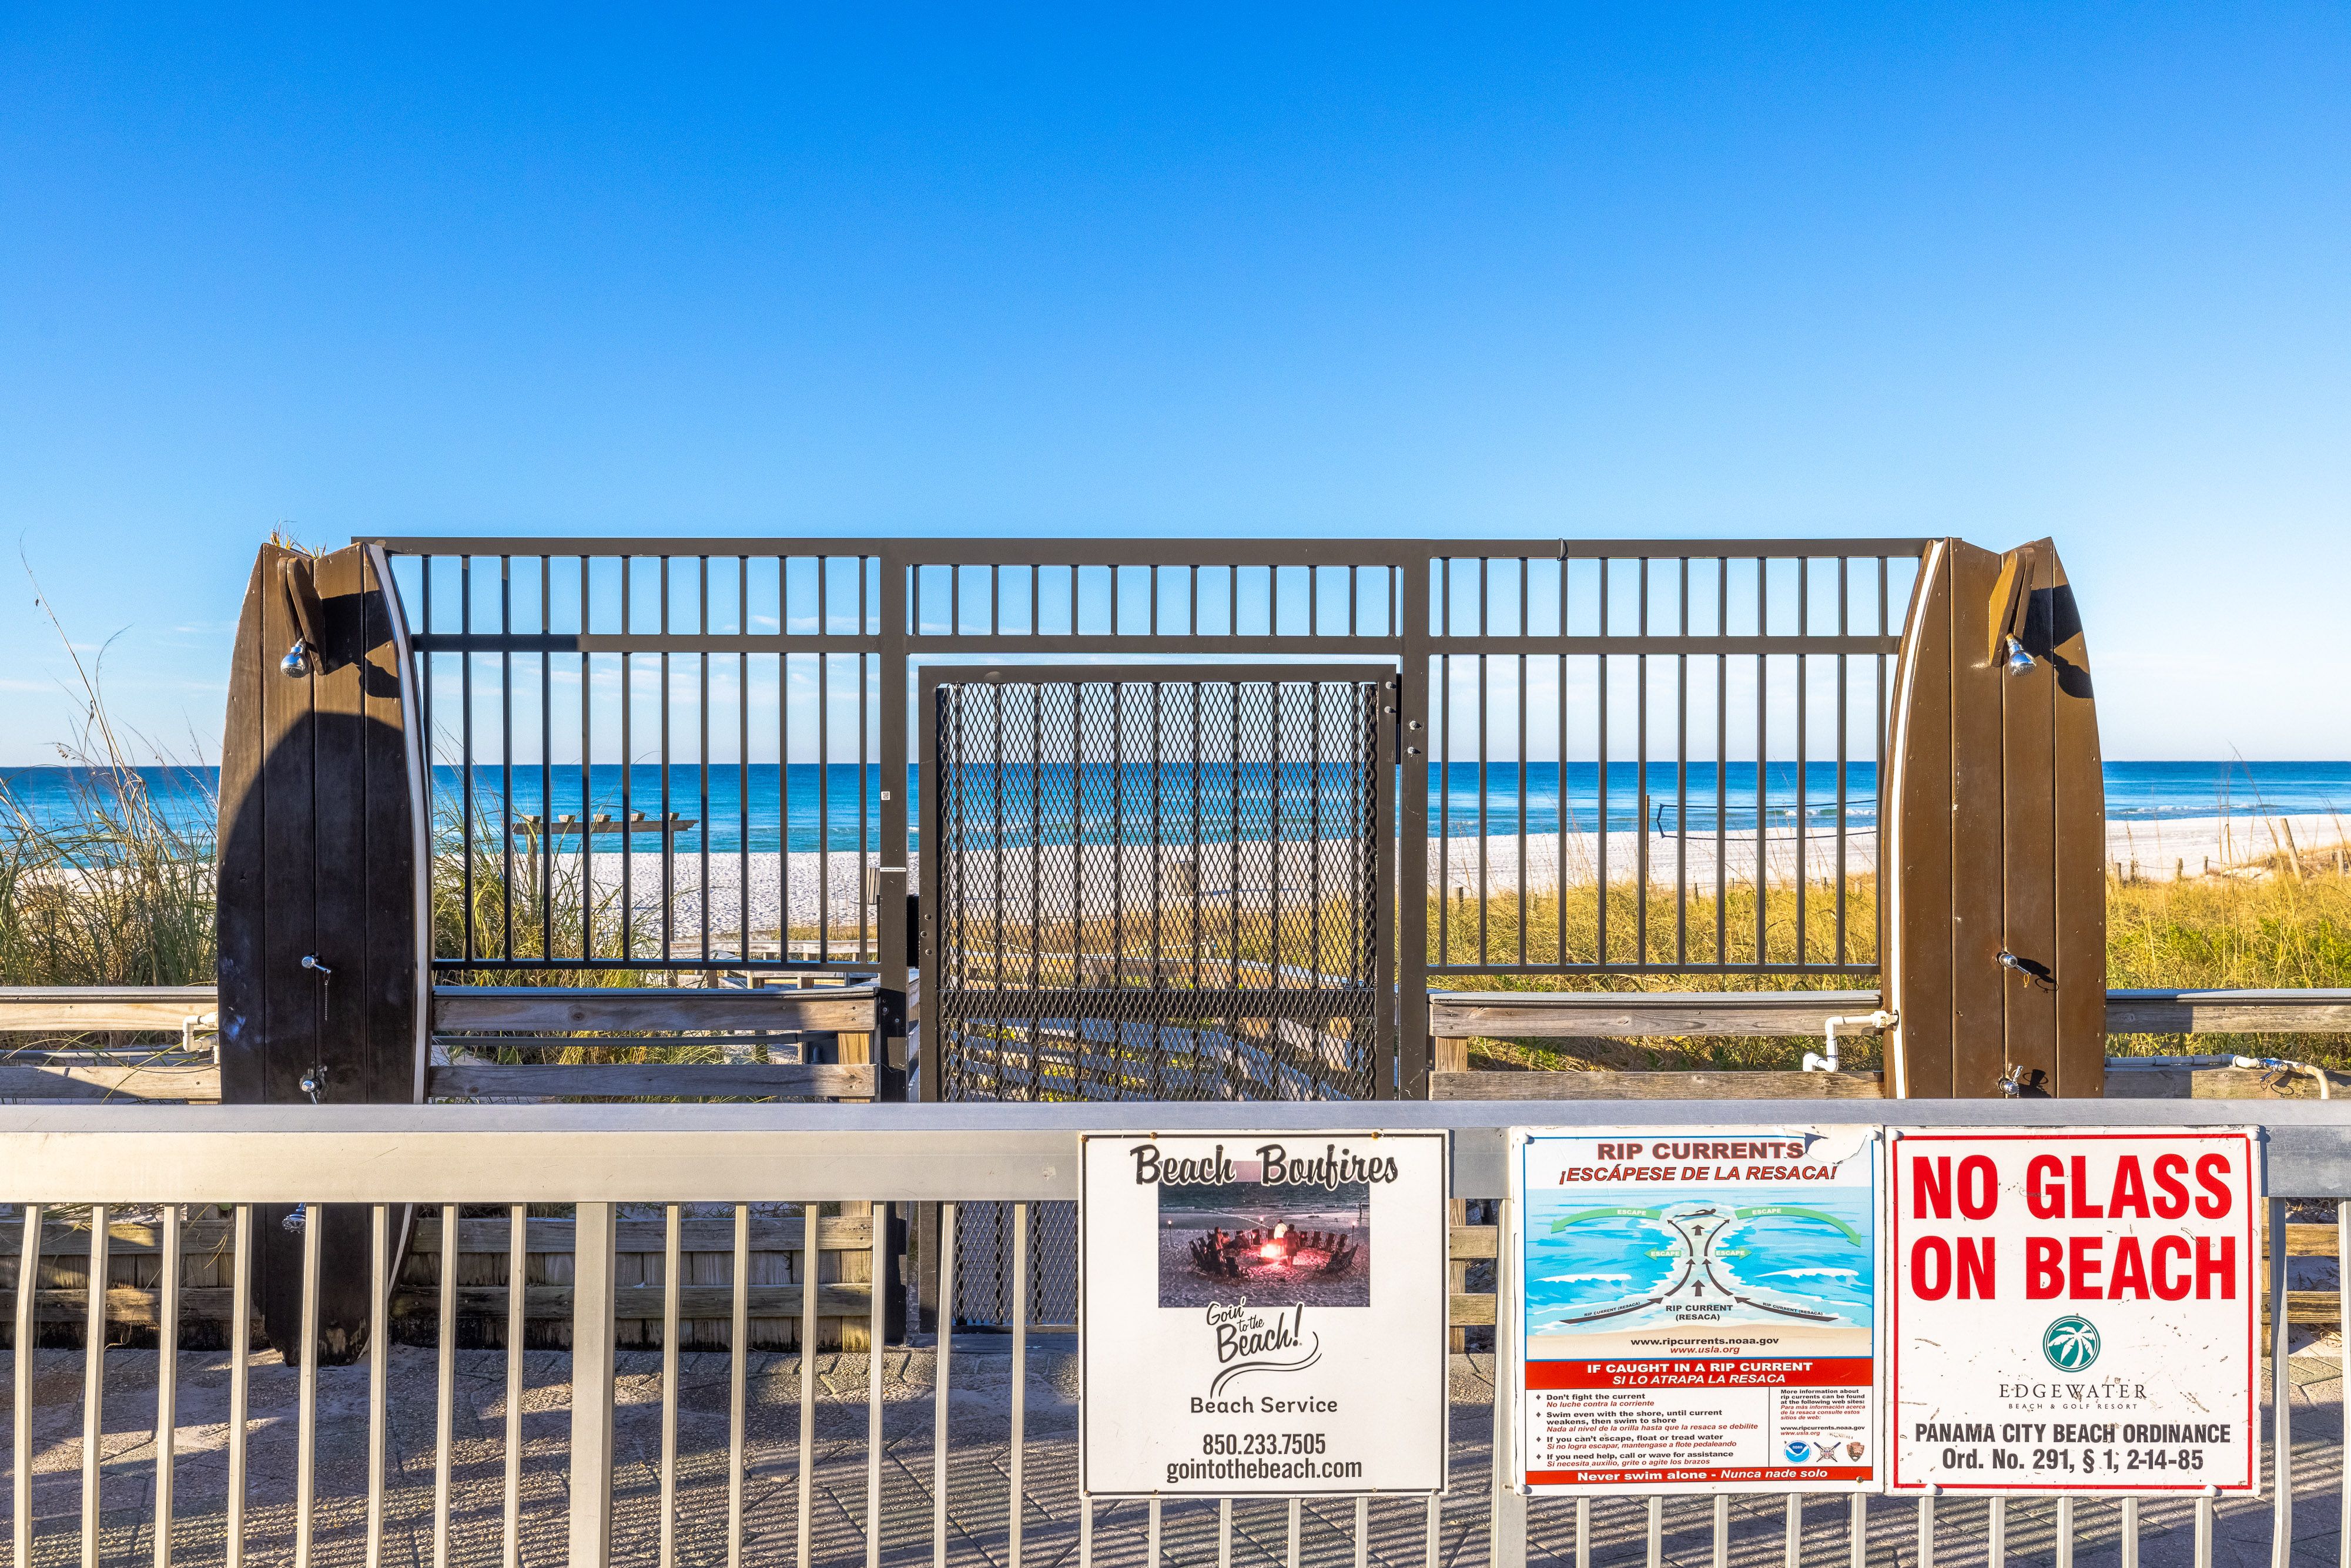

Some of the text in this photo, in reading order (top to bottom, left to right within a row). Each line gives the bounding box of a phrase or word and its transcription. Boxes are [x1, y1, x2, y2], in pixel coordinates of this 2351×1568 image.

[1598, 1142, 1805, 1160] RIP CURRENTS
[1130, 1144, 1398, 1190] Beach Bonfires
[1559, 1164, 1837, 1185] ¡ESCÁPESE DE LA RESACA!
[1913, 1153, 2232, 1220] NO GLASS
[1911, 1235, 2235, 1301] ON BEACH
[1617, 1301, 1640, 1311] (RESACA)
[1237, 1315, 1264, 1332] to the
[1217, 1304, 1303, 1363] Beach!
[1630, 1337, 1779, 1346] www.ripcurrents.noaa.gov
[1670, 1346, 1740, 1354] www.usla.org
[1587, 1362, 1813, 1373] IF CAUGHT IN A RIP CURRENT
[1612, 1374, 1785, 1385] SI LO ATRAPA LA RESACA
[1999, 1383, 2146, 1398] EDGEWATER
[1191, 1396, 1337, 1413] Beach Service
[1915, 1423, 2230, 1443] PANAMA CITY BEACH ORDINANCE
[1203, 1433, 1325, 1455] 850.233.7505
[1943, 1448, 2203, 1473] Ord. No. 291, § 1, 2-14-85
[1166, 1458, 1361, 1483] gointothebeach.com
[1578, 1472, 1620, 1480] Never
[1624, 1471, 1662, 1480] swim
[1667, 1470, 1707, 1479] alone
[1720, 1469, 1761, 1478] Nunca
[1765, 1469, 1796, 1477] nade
[1800, 1469, 1827, 1477] solo
